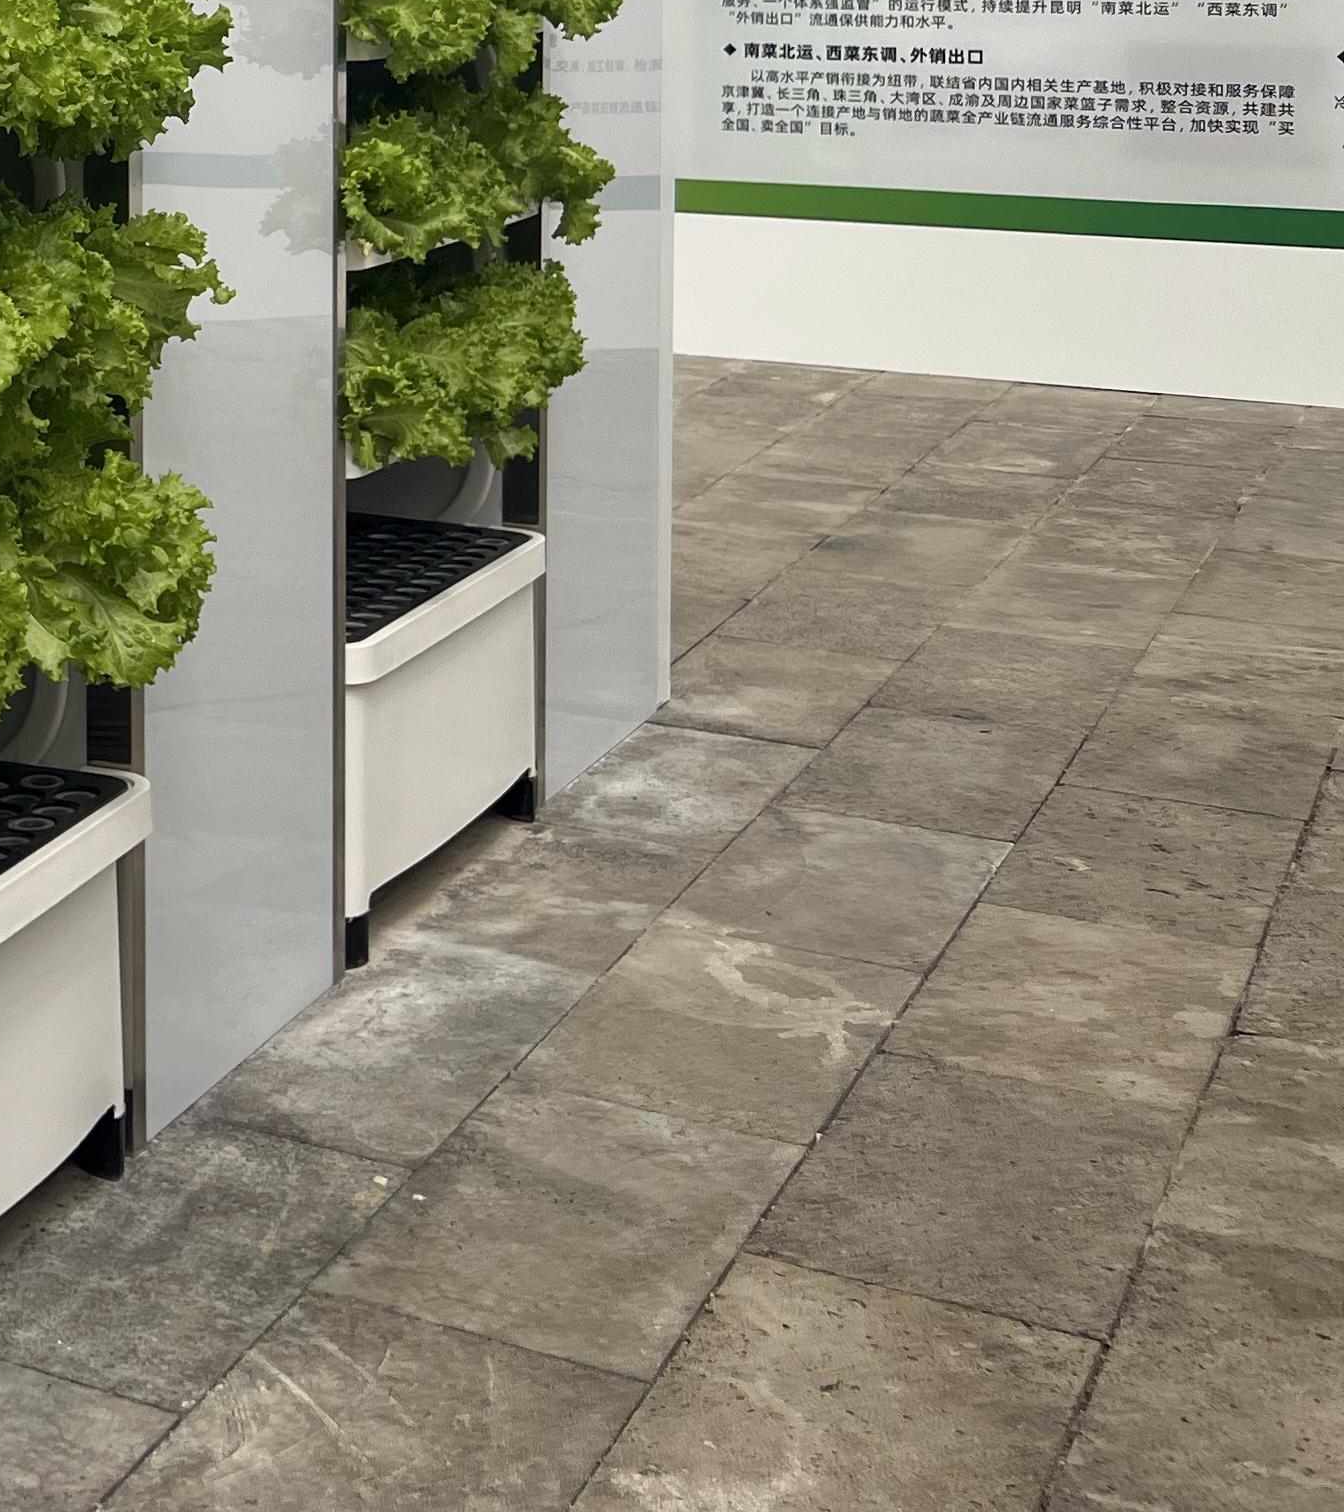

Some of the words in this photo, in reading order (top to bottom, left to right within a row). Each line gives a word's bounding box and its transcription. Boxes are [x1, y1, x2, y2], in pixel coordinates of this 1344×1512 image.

[743, 42, 985, 65] 南菜北运、西菜东调、外销出口
